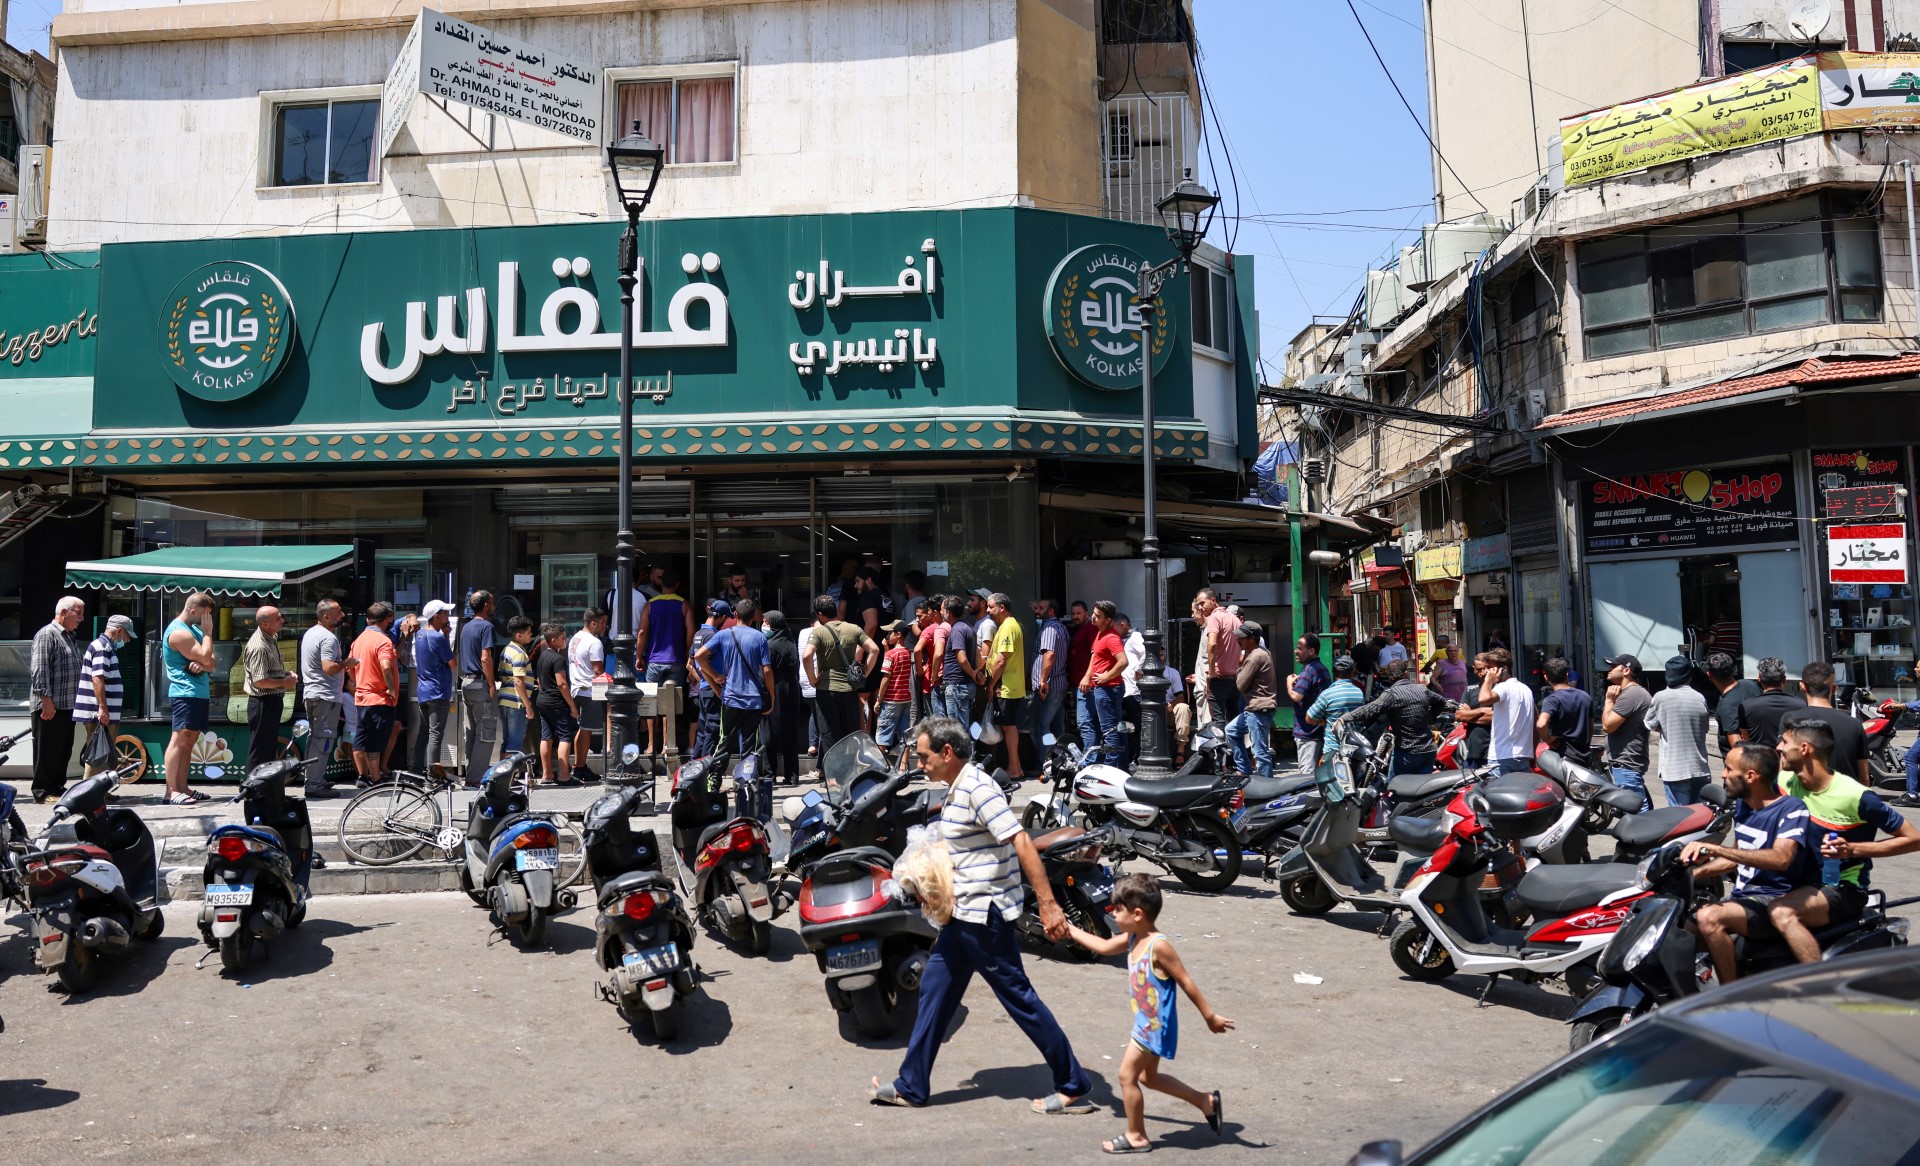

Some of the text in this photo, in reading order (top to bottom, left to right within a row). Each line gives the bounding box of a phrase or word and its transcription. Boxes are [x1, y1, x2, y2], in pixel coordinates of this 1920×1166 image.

[434, 20, 596, 86] الدكتور أحمد حسين المقداد
[447, 61, 475, 75] الشرعي
[476, 68, 494, 80] الطب
[478, 56, 556, 87] طبيب شرعي
[502, 76, 521, 90] العامة
[1688, 75, 1809, 113] مختار
[430, 67, 596, 129] Dr. AHMAD H. EL MOKDAD
[1712, 91, 1792, 120] الغبيري
[433, 82, 592, 141] Tel: 01/545454 03/726378
[1761, 107, 1816, 127] 03/547 767
[1571, 107, 1673, 144] مختار
[1586, 132, 1628, 150] حسن
[1570, 153, 1614, 171] 03/675 535
[787, 238, 937, 310] أفران
[1086, 253, 1138, 274] قلقاس
[197, 270, 251, 293] قلقاس
[360, 252, 729, 386] قلقاس
[789, 328, 938, 376] باتيسري
[1085, 353, 1144, 377] KOLKAS
[192, 368, 254, 389] KOLKAS
[554, 371, 608, 406] لدينا
[617, 370, 674, 404] ليس
[497, 377, 547, 415] فرع
[1593, 471, 1685, 504] SMART
[1746, 521, 1794, 532] صيانة فورية
[1834, 542, 1901, 567] مختار
[803, 830, 826, 846] CHAMP
[206, 893, 251, 905] M935527
[829, 951, 877, 970] M676791
